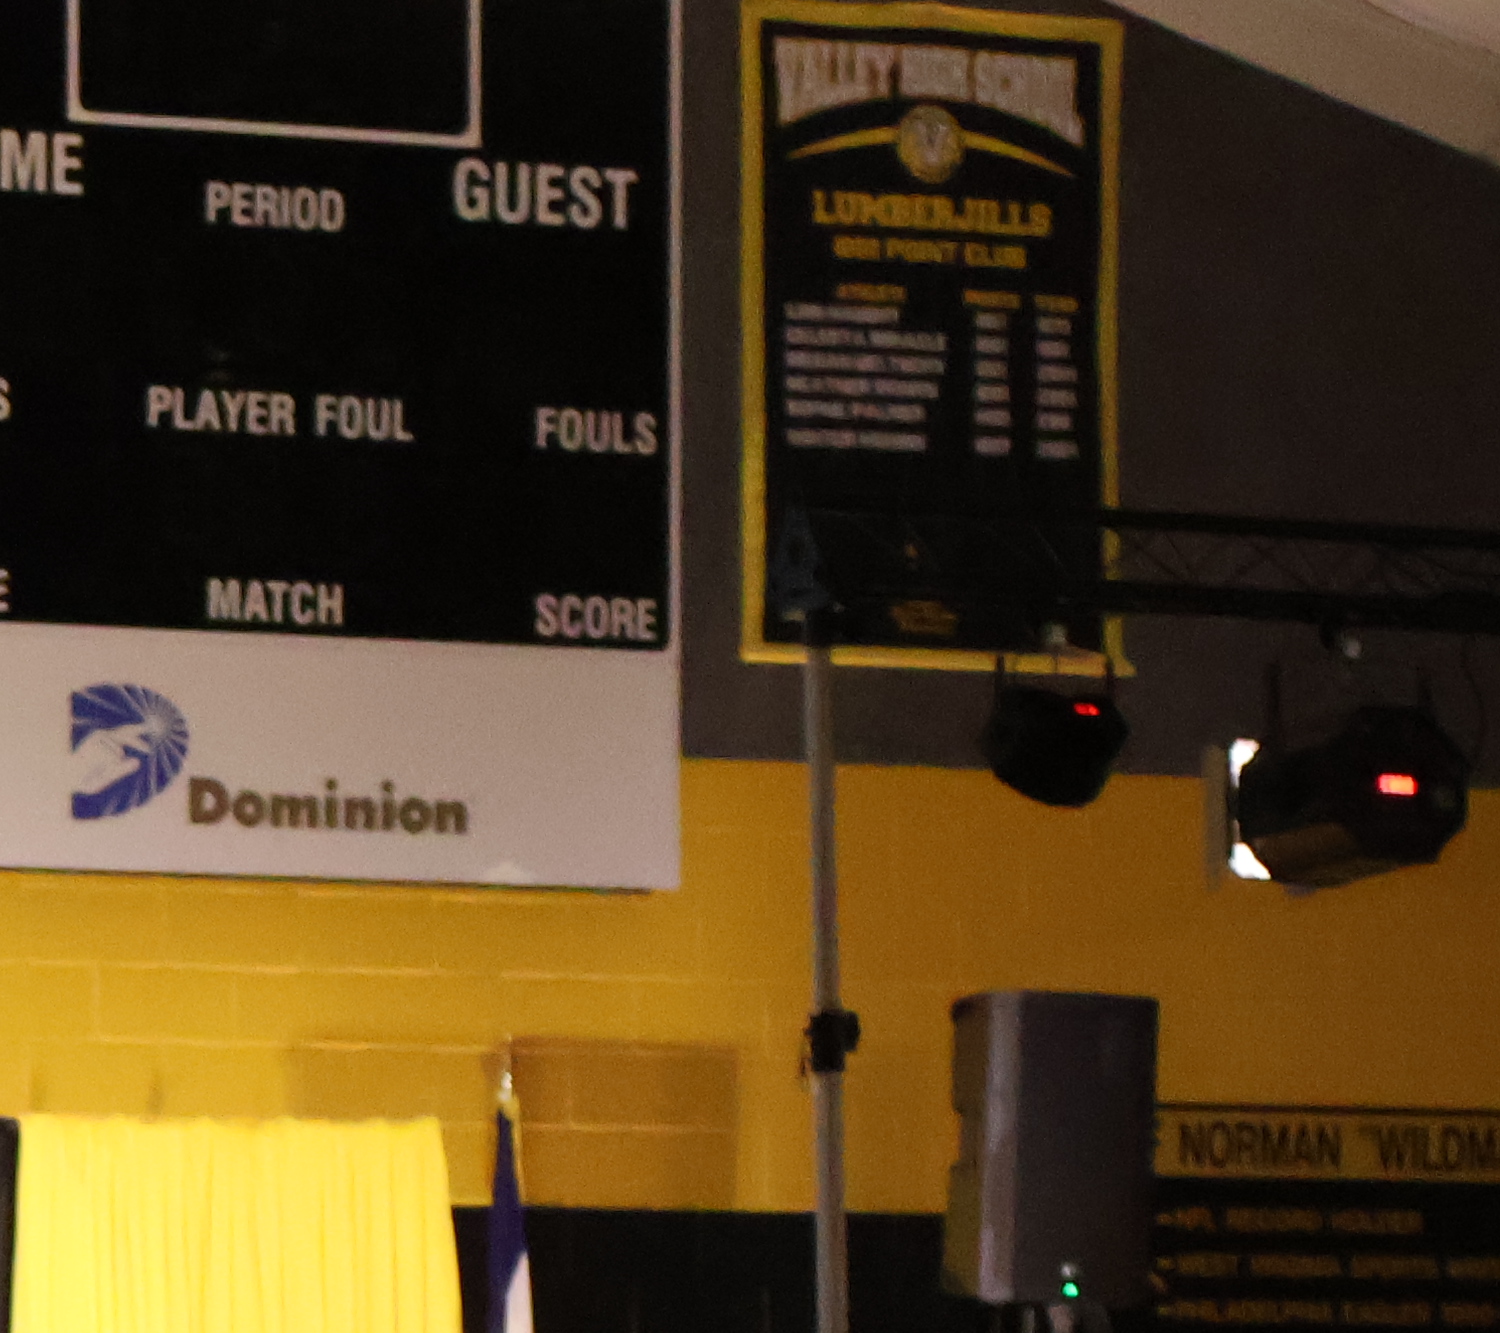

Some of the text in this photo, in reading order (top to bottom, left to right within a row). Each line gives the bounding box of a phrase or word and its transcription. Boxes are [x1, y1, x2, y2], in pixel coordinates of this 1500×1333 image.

[205, 180, 346, 233] PERIOD
[453, 158, 639, 230] GUEST
[147, 384, 414, 443] PLAYER FOUL
[535, 406, 657, 456] FOULS
[207, 578, 345, 627] MATCH
[535, 594, 657, 641] SCORE
[189, 777, 469, 836] Dominion
[1178, 1121, 1342, 1170] NORMAN
